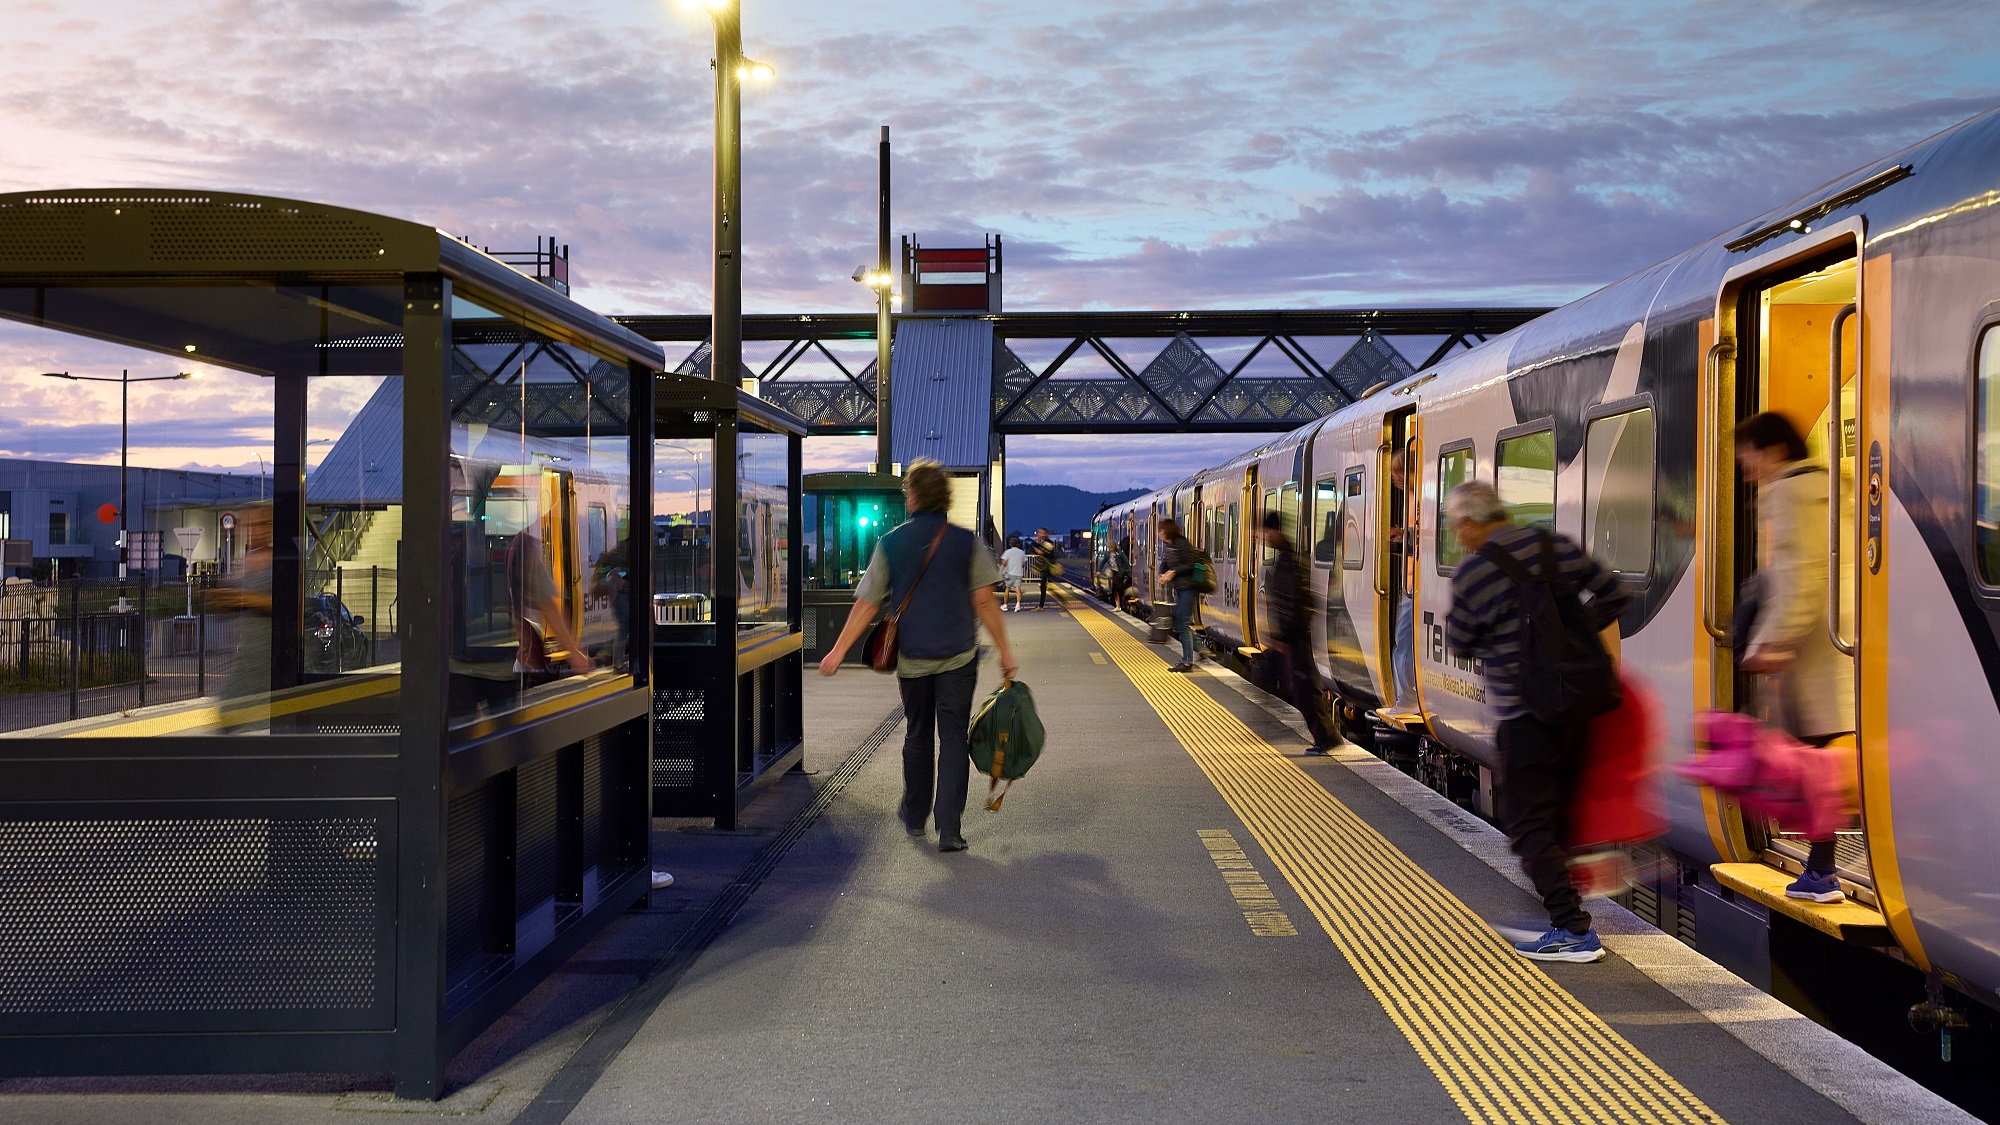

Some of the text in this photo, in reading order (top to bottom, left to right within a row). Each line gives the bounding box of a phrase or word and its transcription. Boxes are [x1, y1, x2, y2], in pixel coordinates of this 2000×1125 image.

[1442, 672, 1459, 695] Waikato
[1460, 679, 1464, 697] &
[1465, 681, 1486, 704] Auckland
